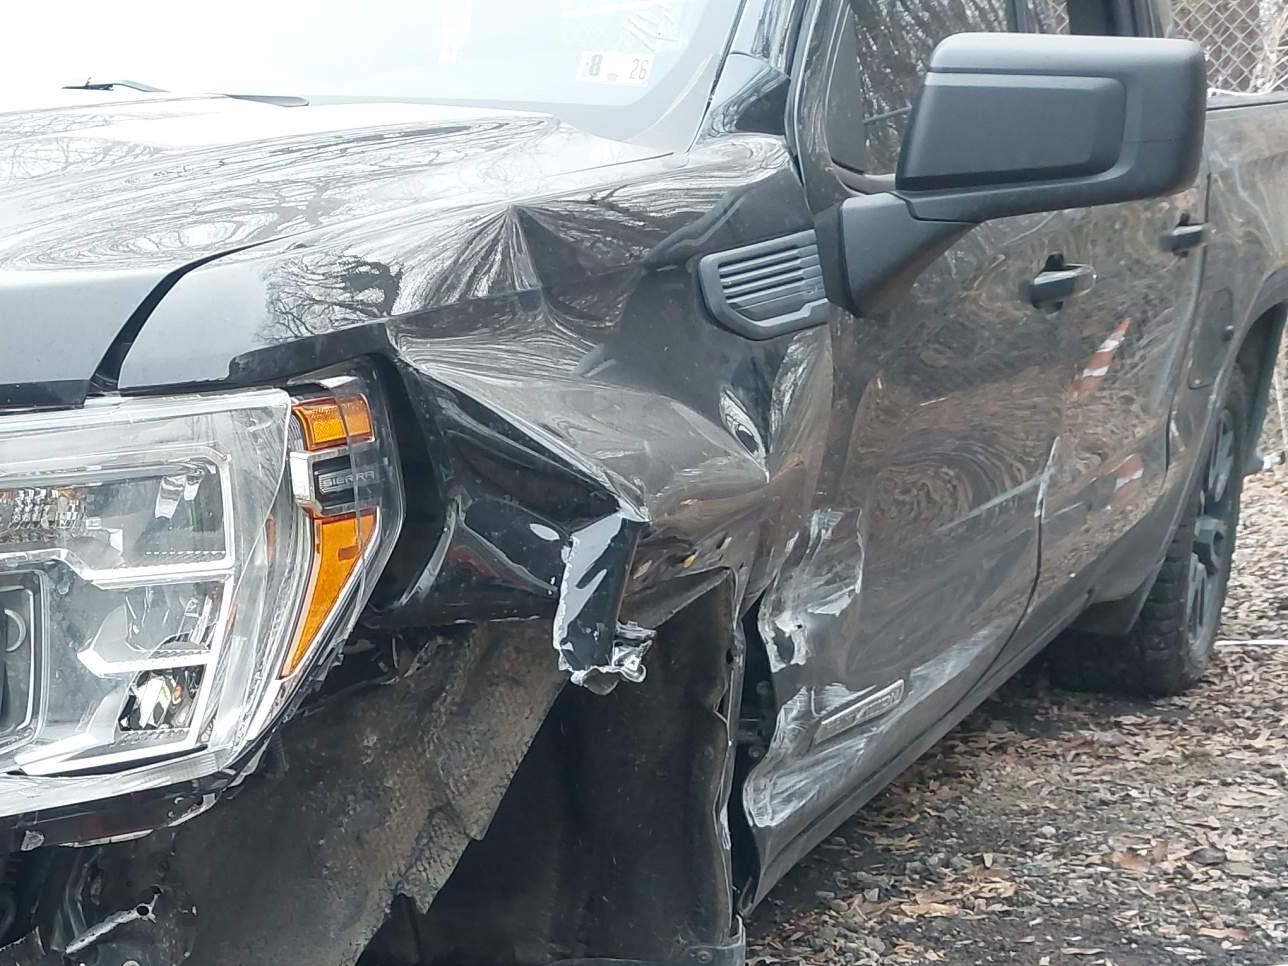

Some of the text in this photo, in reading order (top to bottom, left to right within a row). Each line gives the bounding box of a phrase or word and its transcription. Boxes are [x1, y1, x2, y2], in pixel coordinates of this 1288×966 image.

[588, 53, 649, 81] 8 26
[322, 470, 376, 488] SIERRA
